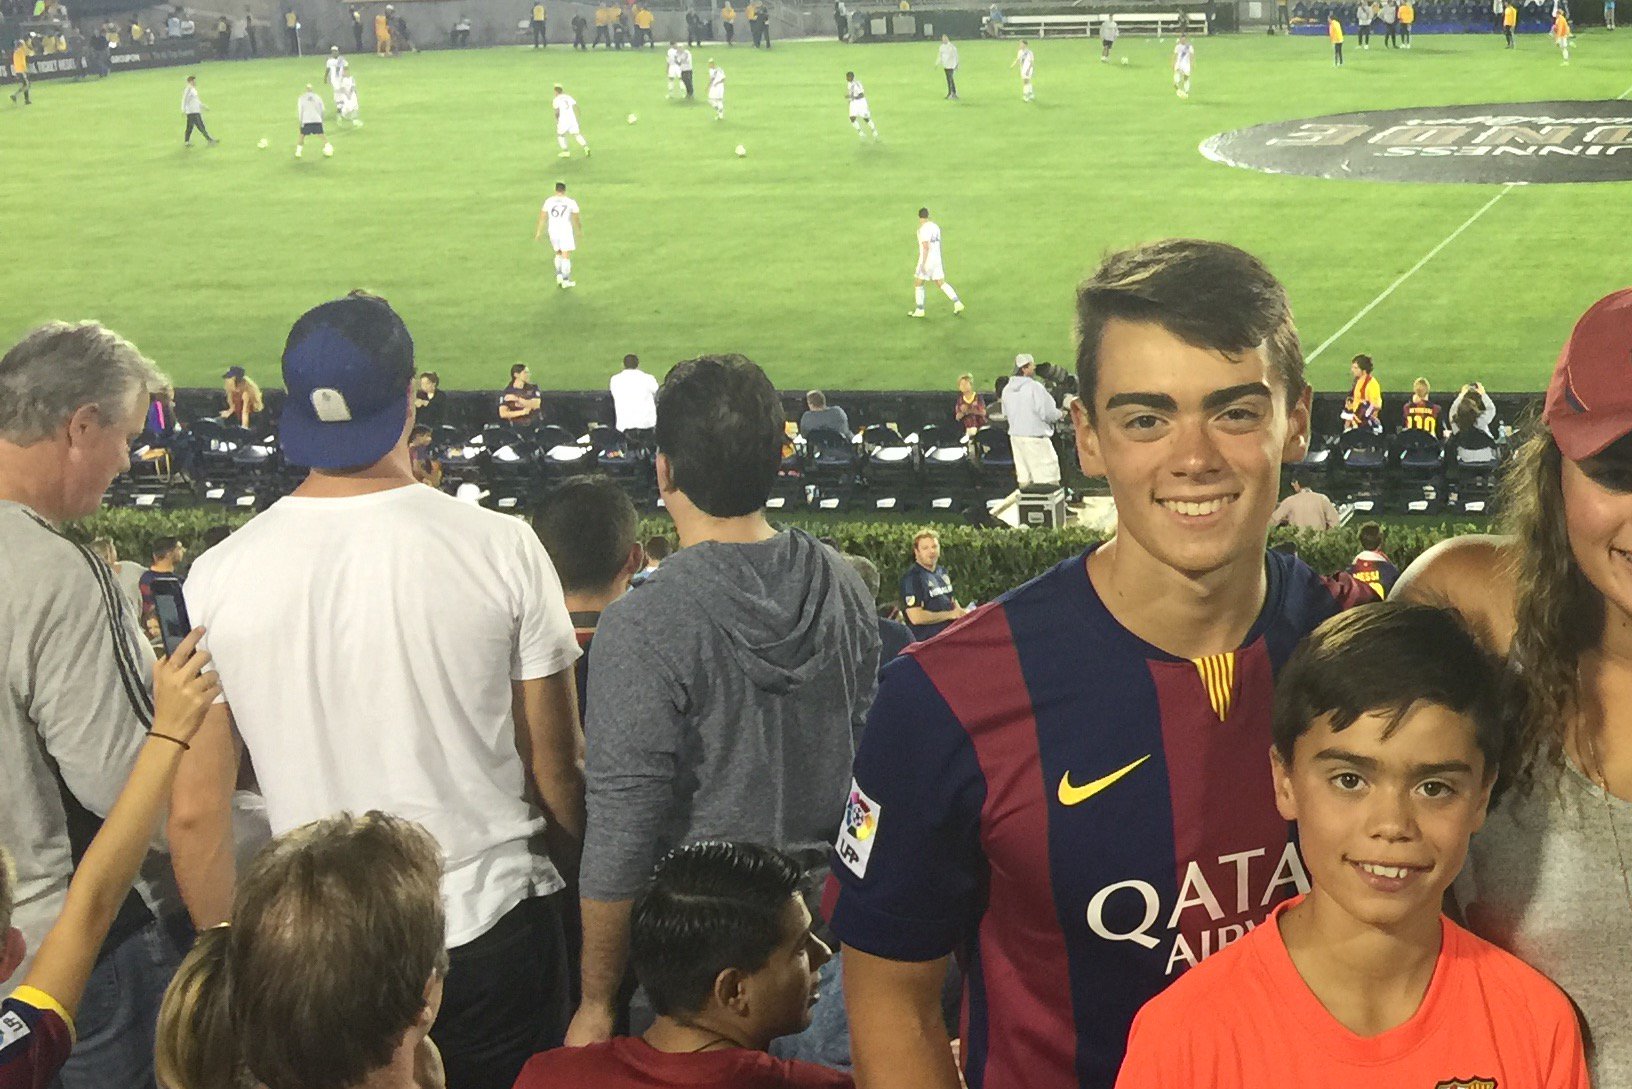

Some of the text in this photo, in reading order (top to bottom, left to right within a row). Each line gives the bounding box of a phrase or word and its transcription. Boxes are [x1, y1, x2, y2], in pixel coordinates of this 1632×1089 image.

[550, 204, 568, 218] 67
[1353, 570, 1380, 582] ESSI
[1164, 915, 1258, 976] AIR
